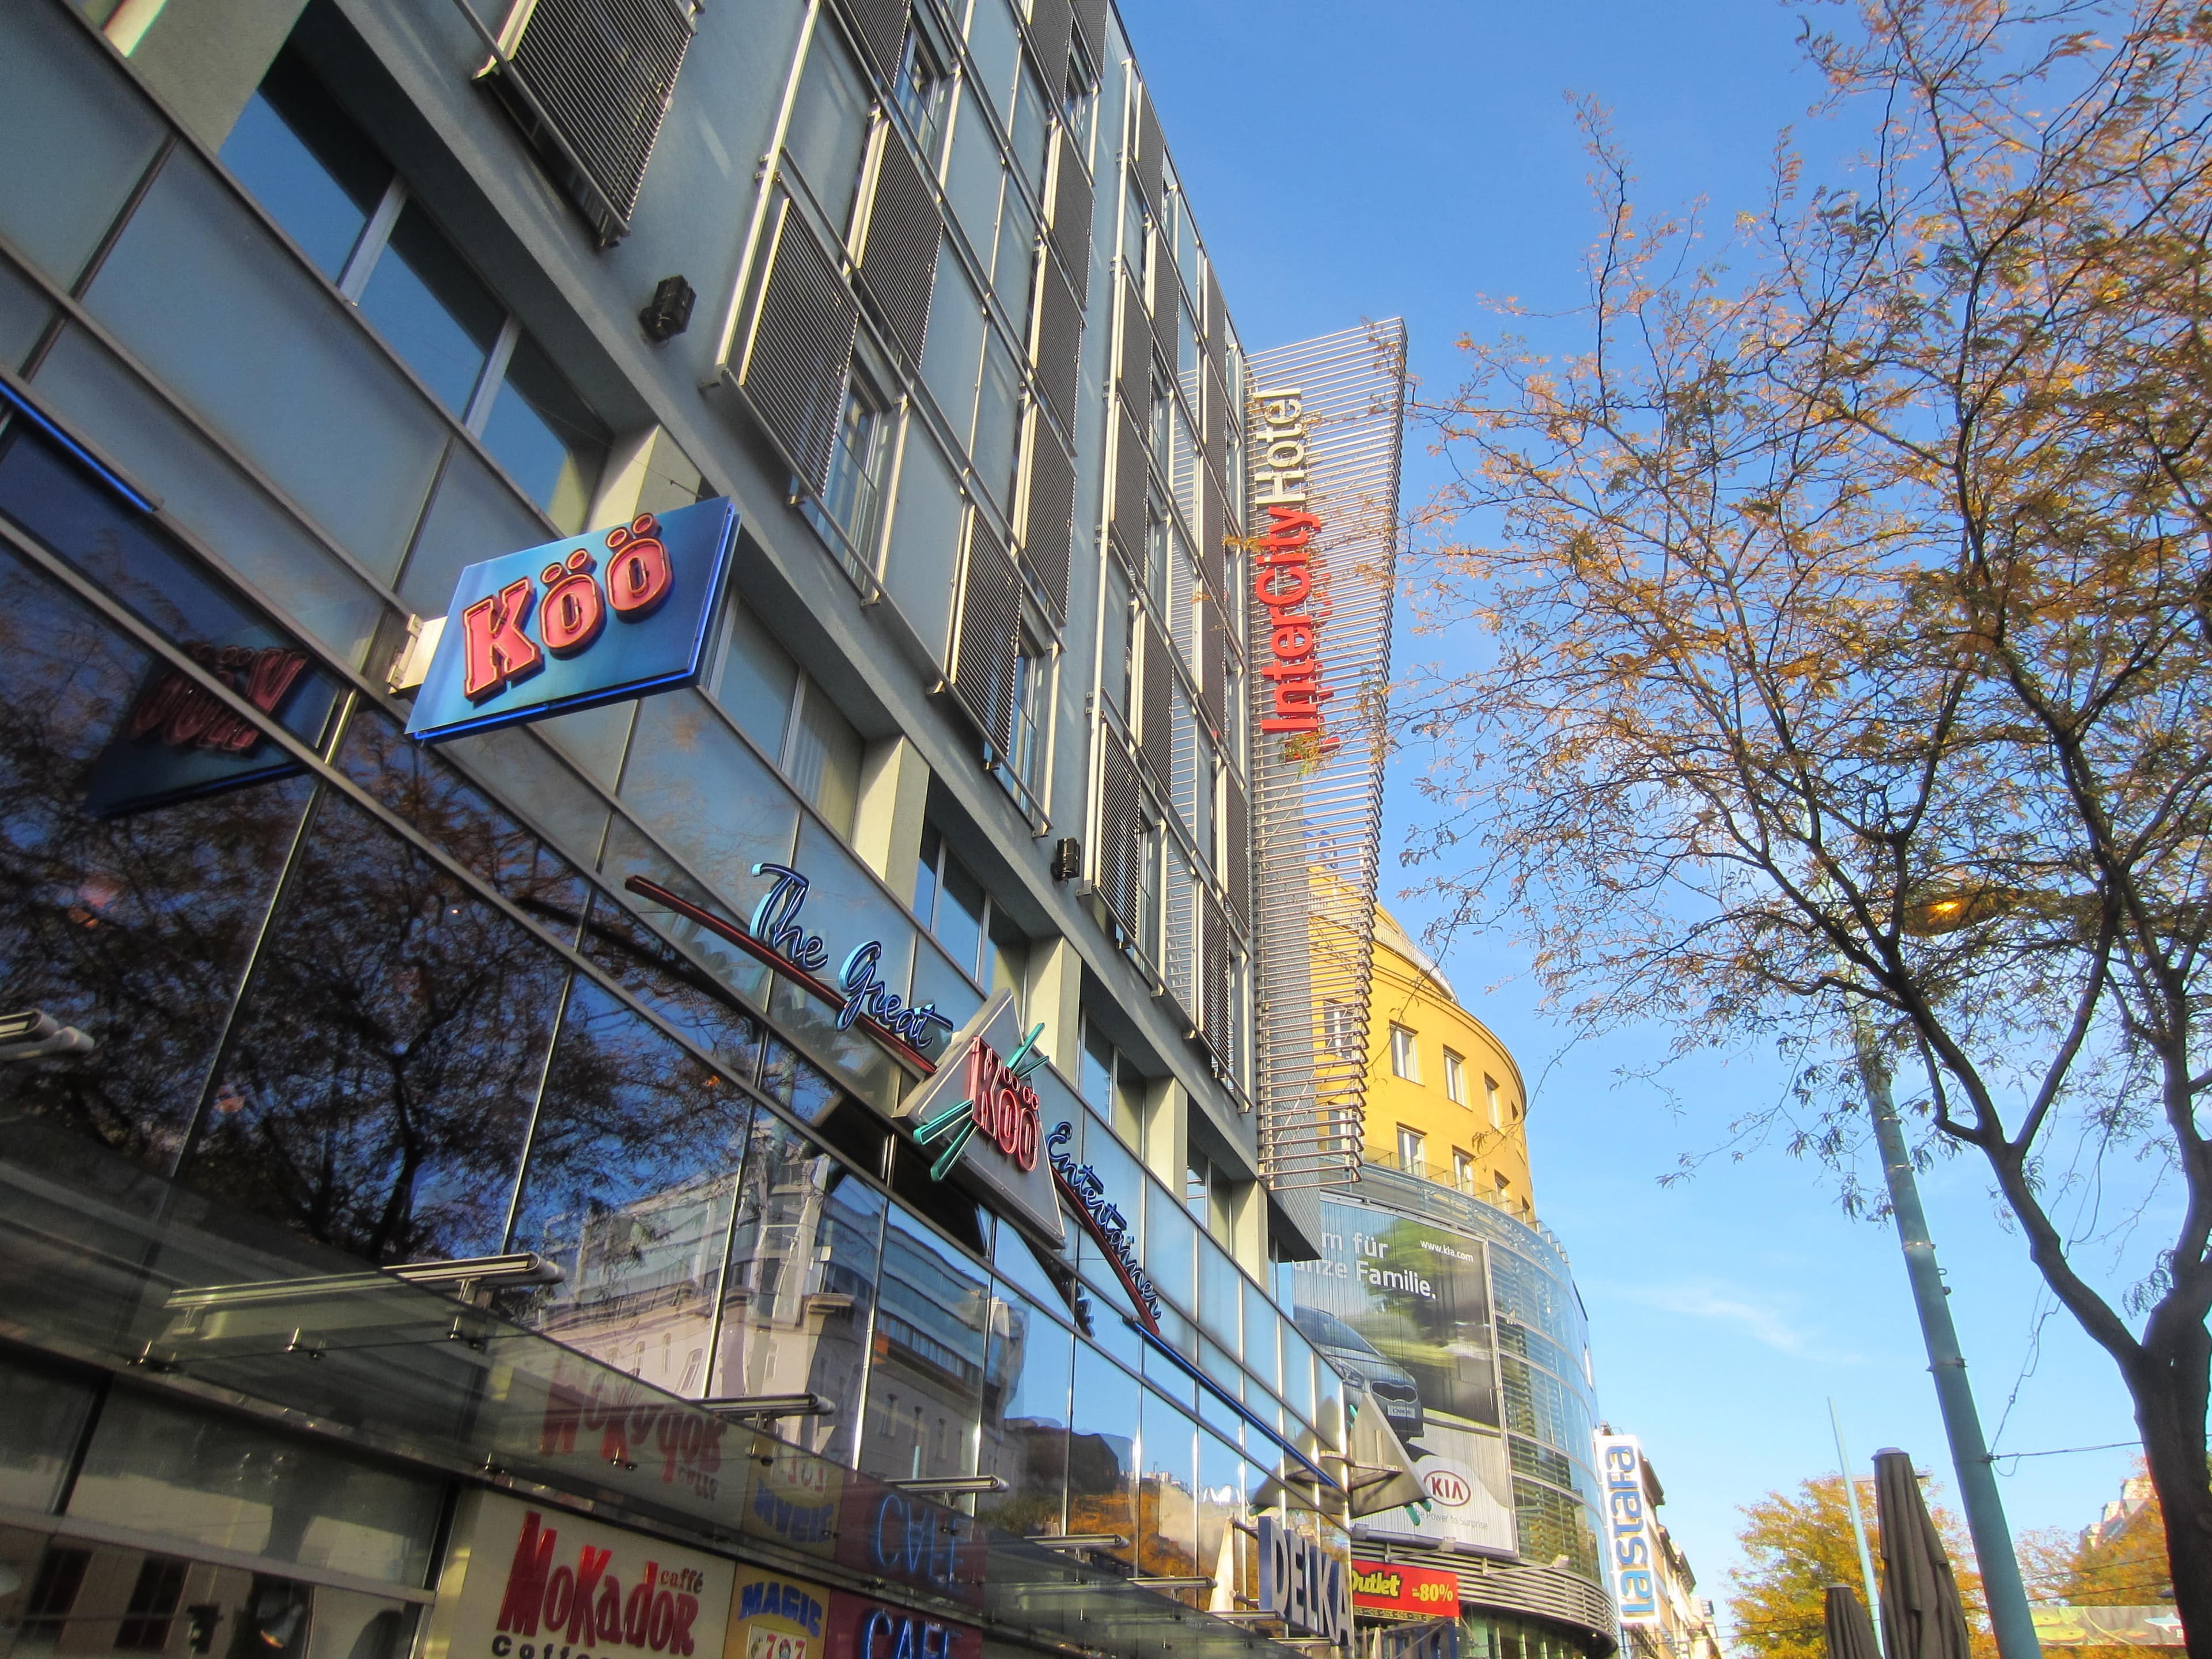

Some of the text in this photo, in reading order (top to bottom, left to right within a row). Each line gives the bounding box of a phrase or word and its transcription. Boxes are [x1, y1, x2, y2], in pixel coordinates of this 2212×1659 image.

[1252, 387, 1321, 734] InterCity Hotel
[749, 862, 955, 1051] The Great
[1045, 1120, 1162, 1320] Entertainer
[1352, 1232, 1389, 1259] für
[1419, 1238, 1475, 1263] www.kia.com
[1291, 1258, 1438, 1301] anze Familie.
[1431, 1476, 1464, 1501] KIA
[1426, 1512, 1448, 1522] Power
[1450, 1515, 1458, 1524] to
[1258, 1516, 1354, 1651] DELKA
[738, 1582, 824, 1638] MAGIC
[491, 1634, 613, 1659] Coff
